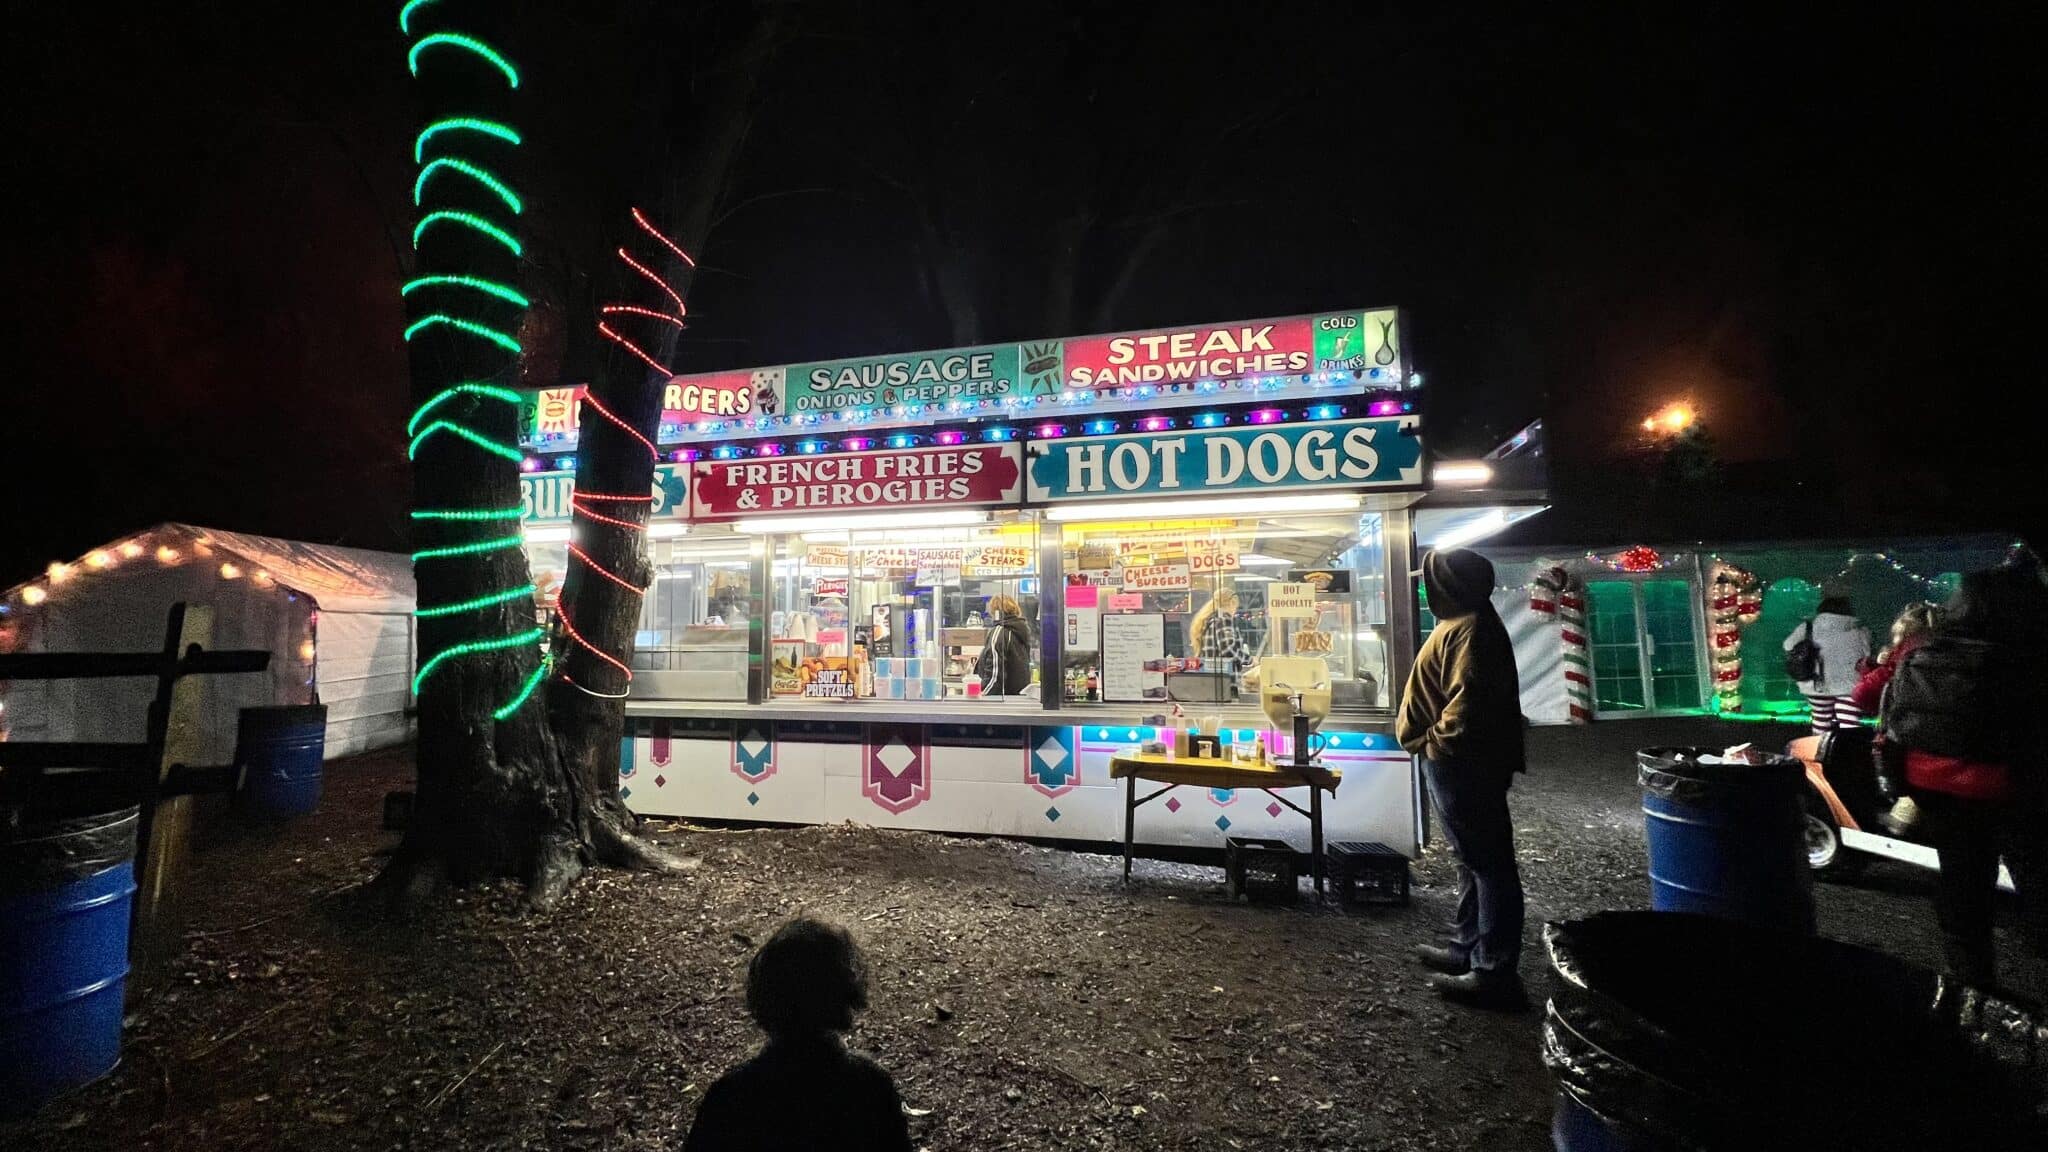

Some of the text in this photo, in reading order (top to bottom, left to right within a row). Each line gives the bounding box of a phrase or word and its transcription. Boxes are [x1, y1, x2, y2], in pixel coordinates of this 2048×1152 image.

[1320, 316, 1356, 330] COLD
[1107, 325, 1274, 365] STEAK
[1069, 350, 1309, 388] SANDWICHES
[1320, 354, 1364, 370] DRINKS
[810, 353, 994, 392] SAUSAGE
[796, 390, 875, 410] ONIONS
[903, 379, 1010, 401] PEPPERS
[1066, 427, 1378, 493] HOT DOGS
[726, 451, 983, 486] FRENCH FRIES
[736, 479, 971, 509] & PIEROGIES
[920, 550, 960, 560] SAUSAGE
[984, 547, 1025, 556] CHEESE
[981, 555, 1025, 566] STEAKS
[1193, 553, 1235, 569] DOGS
[1136, 575, 1188, 587] BURGERS
[1283, 585, 1300, 594] HOT
[1271, 599, 1312, 608] CHOCOLATE
[817, 670, 841, 683] SOFT
[806, 683, 854, 697] PRETZELS
